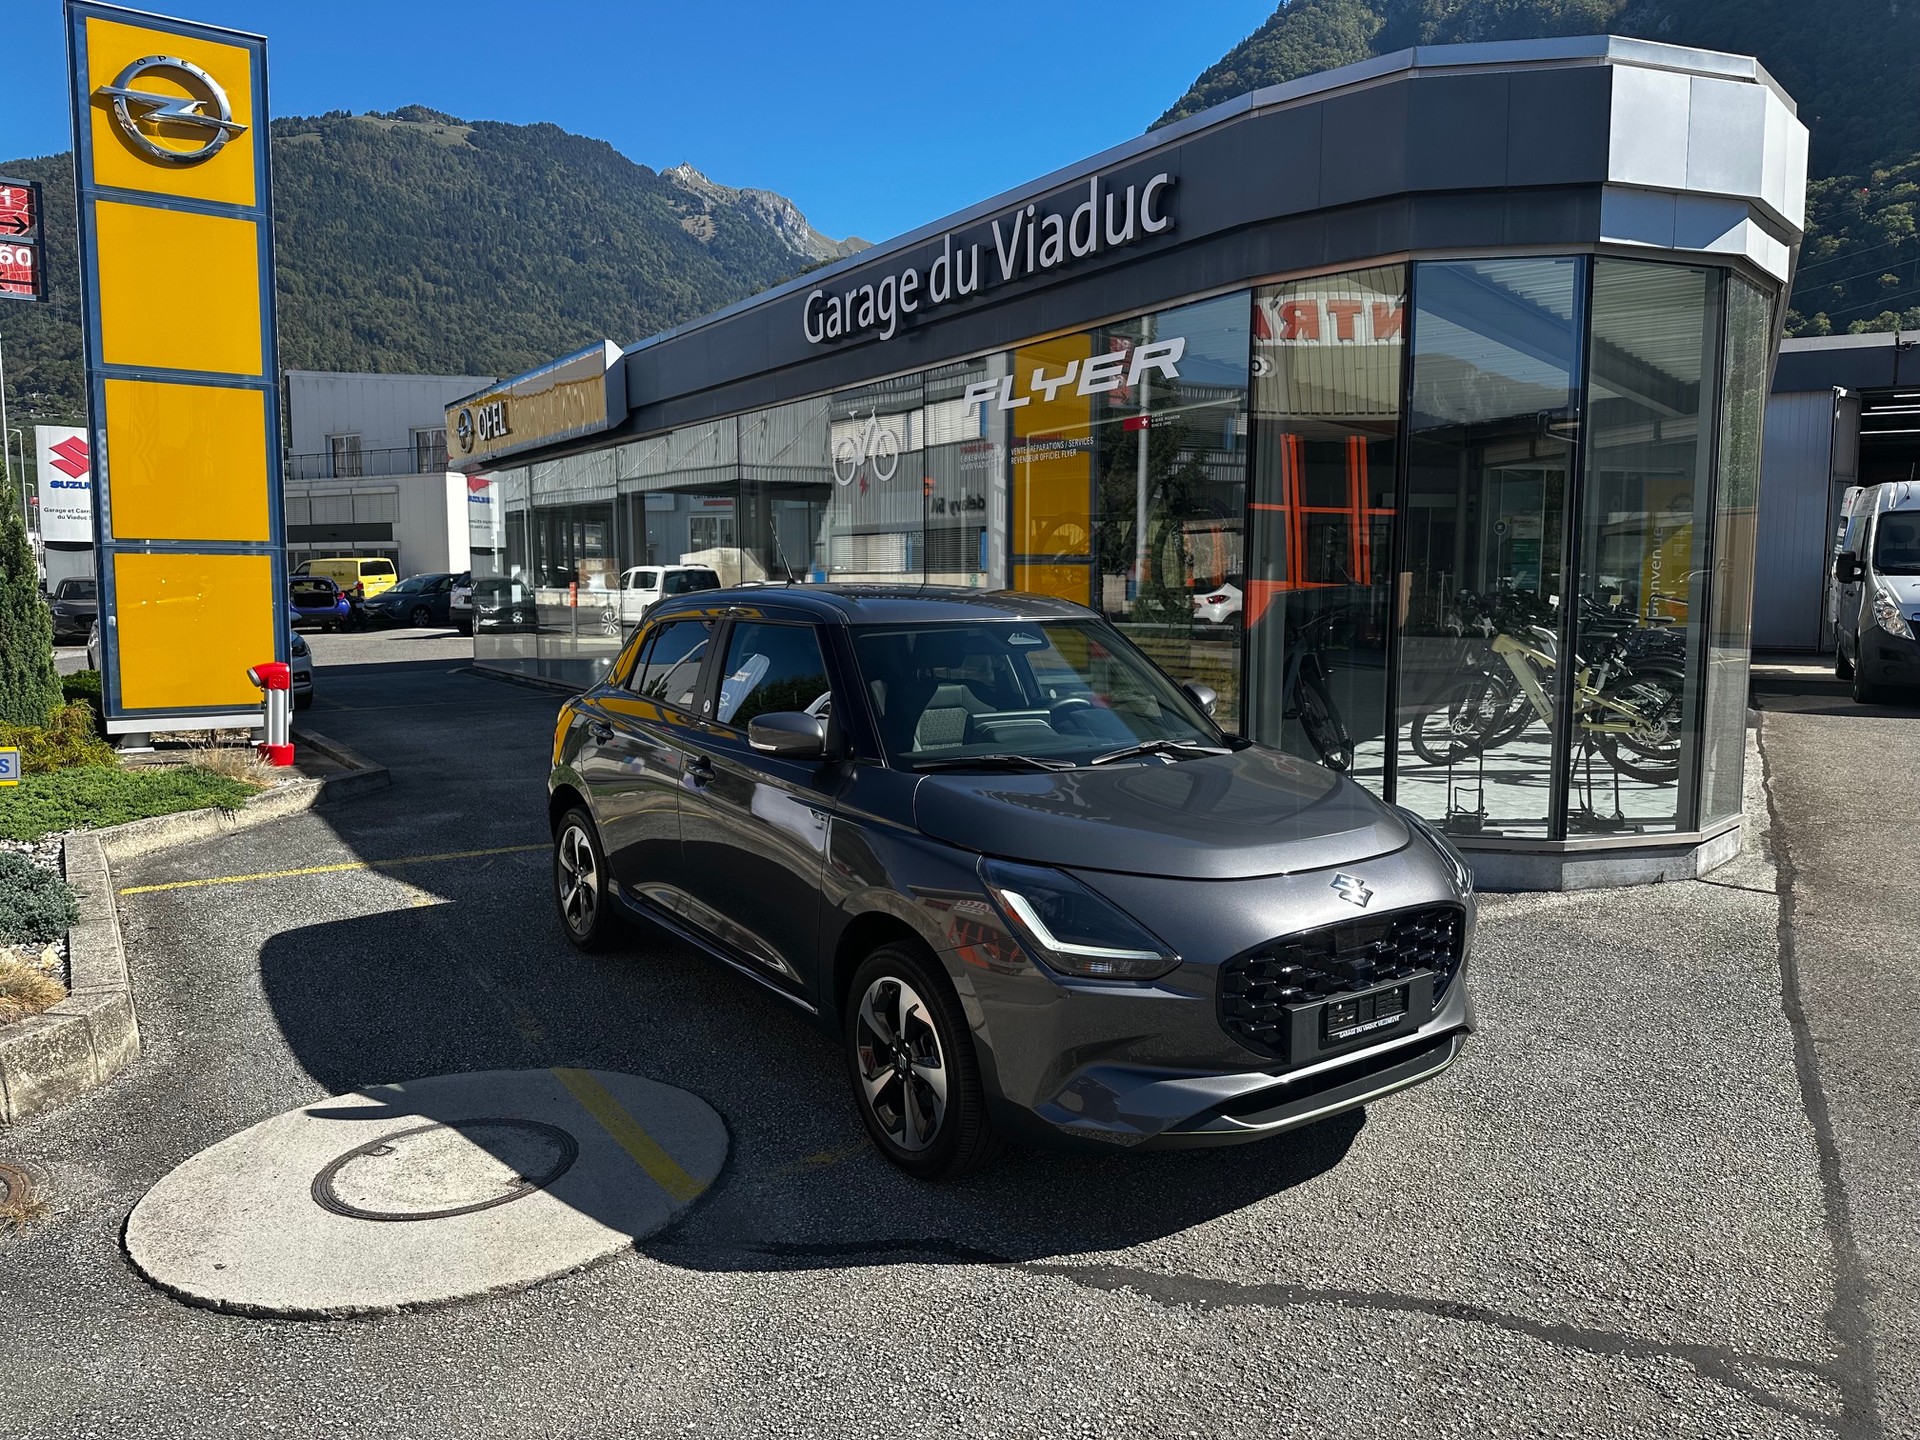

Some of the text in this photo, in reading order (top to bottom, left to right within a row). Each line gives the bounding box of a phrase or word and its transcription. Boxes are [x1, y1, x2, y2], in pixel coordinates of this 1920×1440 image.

[135, 55, 207, 79] OPEL
[803, 172, 1175, 344] Garage du Viaduc
[963, 336, 1187, 417] FLYER
[477, 400, 508, 441] OPEL
[1061, 448, 1077, 458] FLYER
[1068, 436, 1094, 448] SERVICES
[49, 480, 91, 489] SUZU
